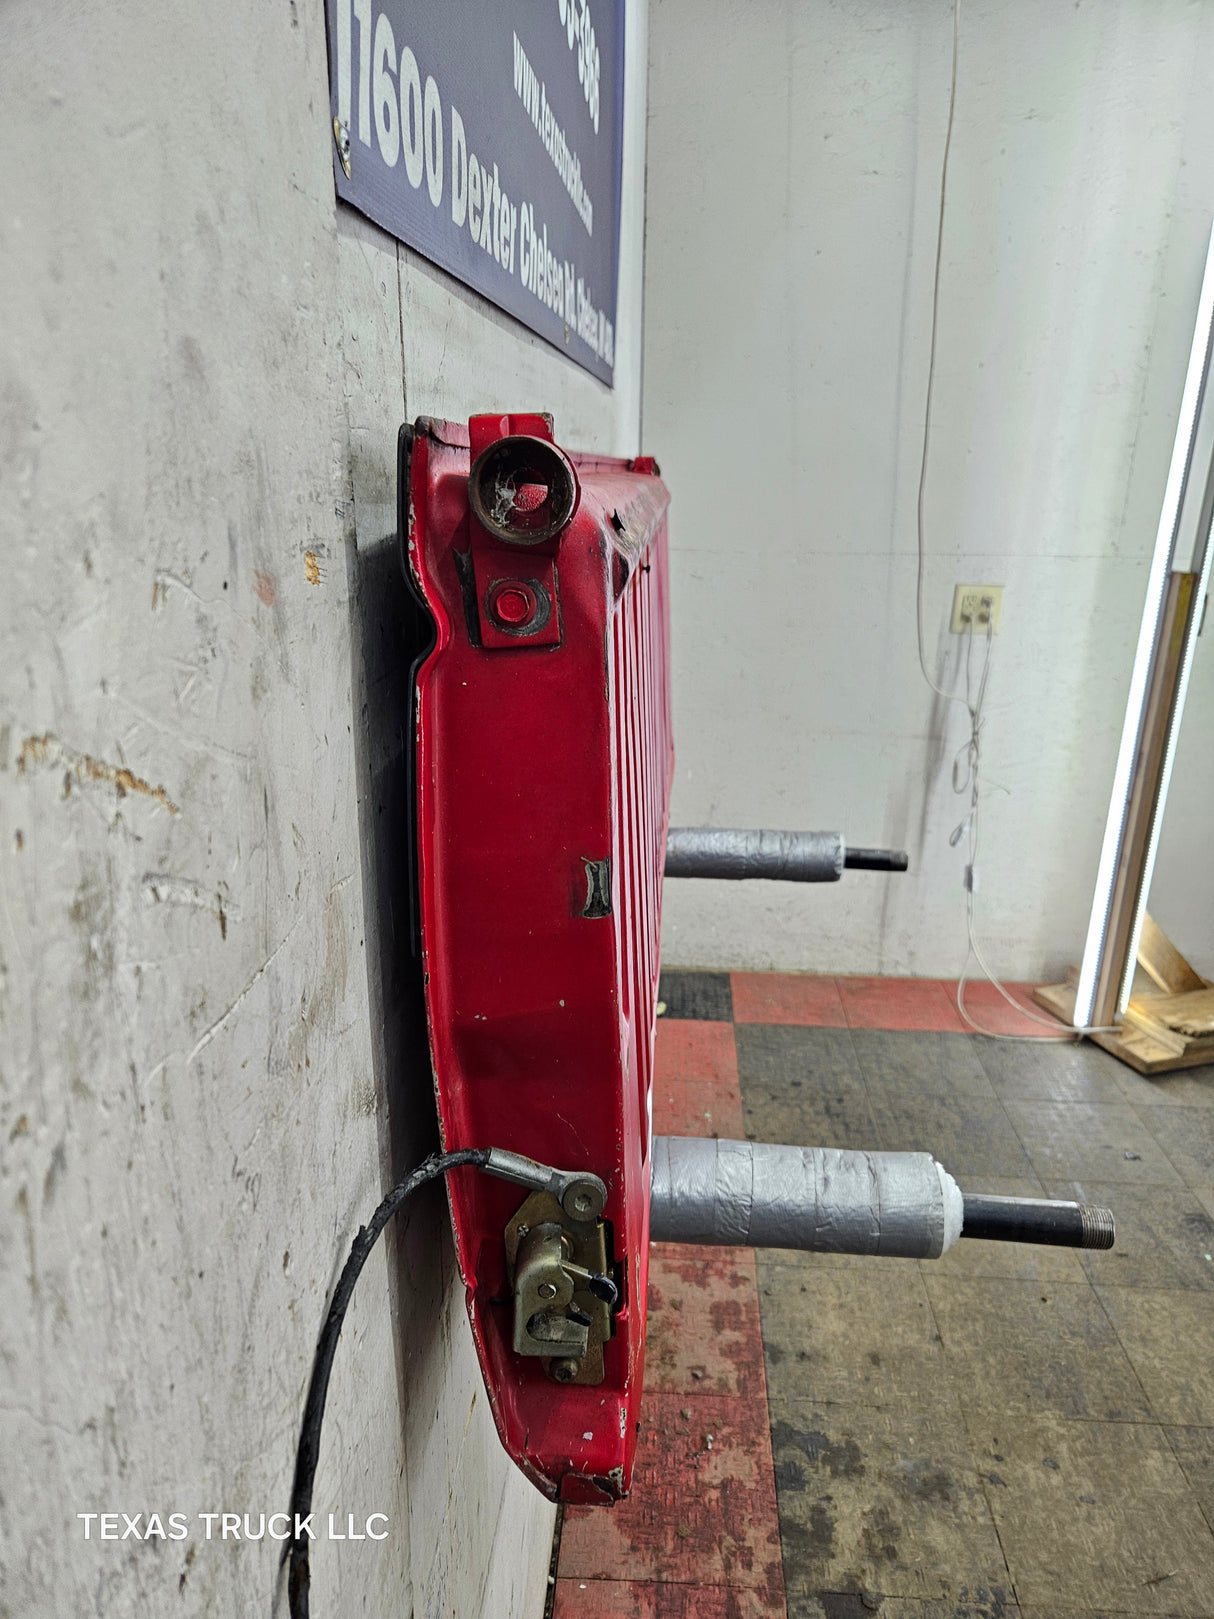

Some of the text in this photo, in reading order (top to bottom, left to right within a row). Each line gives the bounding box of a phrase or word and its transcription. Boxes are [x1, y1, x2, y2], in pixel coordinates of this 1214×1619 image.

[336, 0, 444, 208] 11600
[451, 105, 517, 276] Dexter
[520, 201, 565, 319] Chelsea
